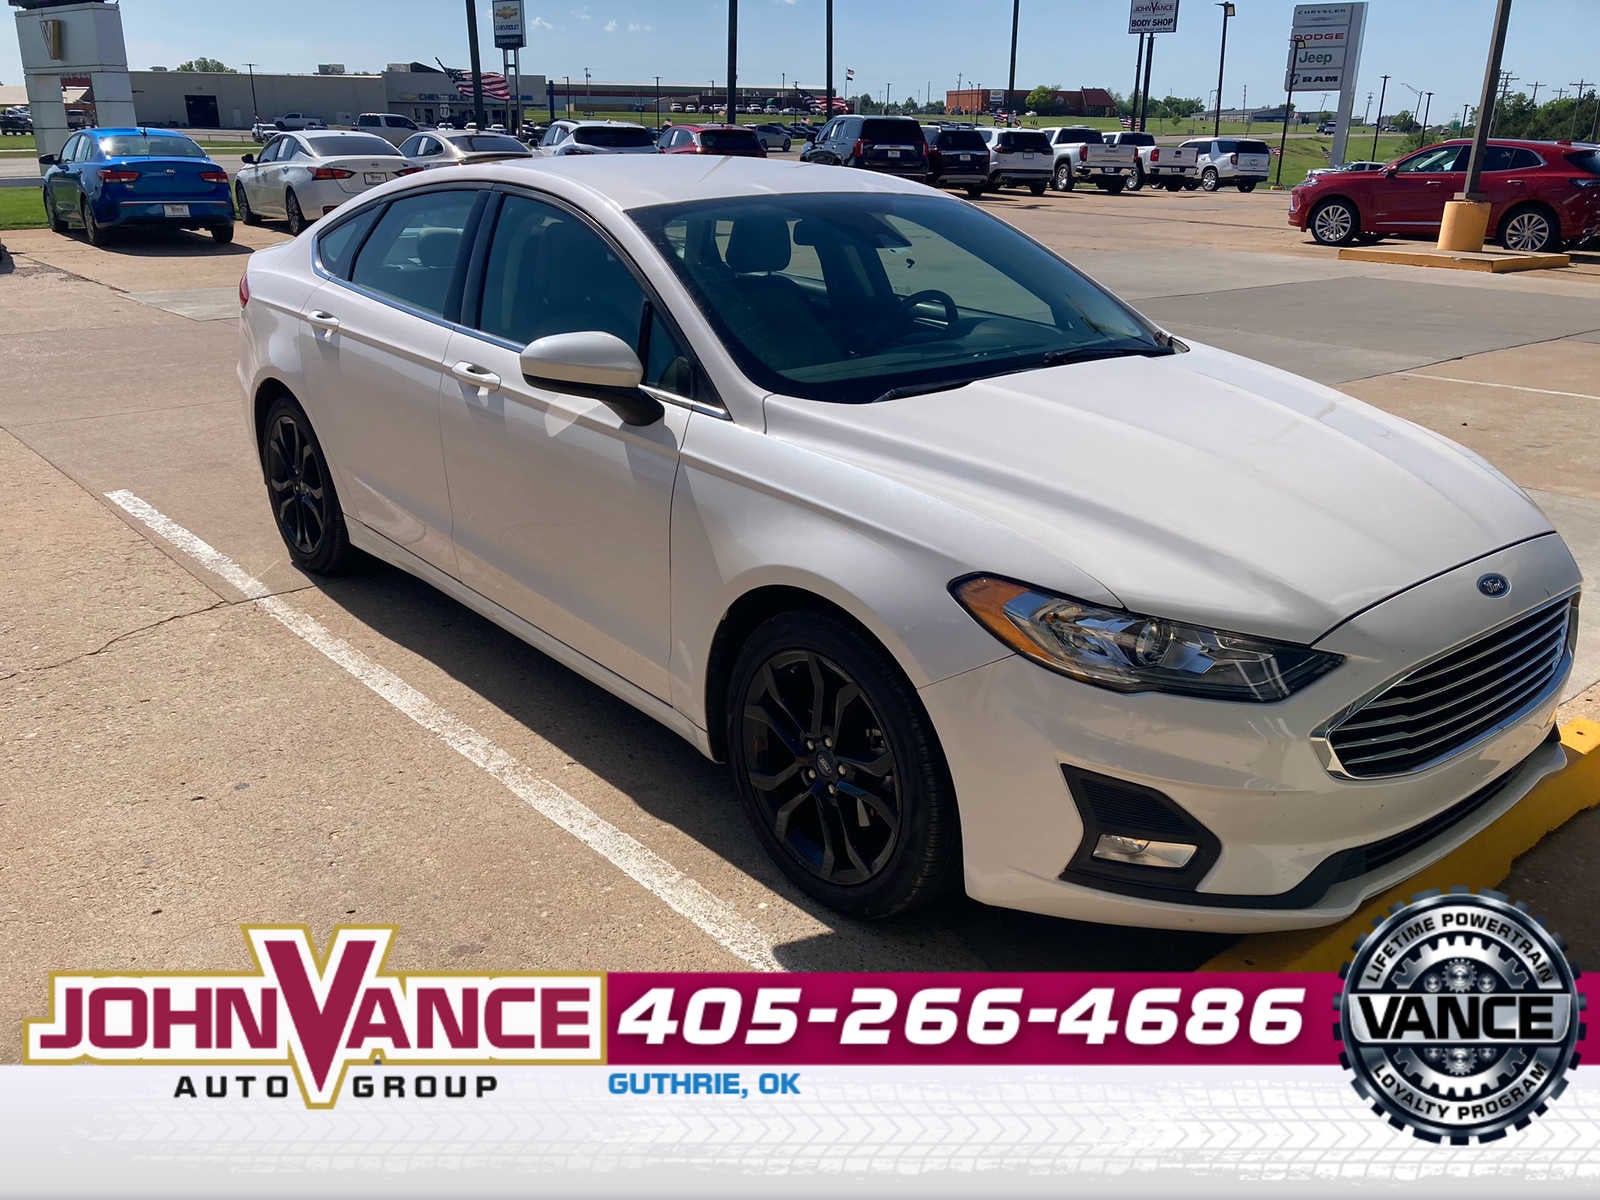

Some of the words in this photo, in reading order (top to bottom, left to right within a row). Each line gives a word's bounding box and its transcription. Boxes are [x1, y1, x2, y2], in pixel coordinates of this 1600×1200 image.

[1131, 19, 1151, 27] BODY
[1152, 18, 1173, 26] SHOP
[1294, 32, 1345, 41] DODGE
[1299, 51, 1332, 65] Jeep
[1302, 75, 1339, 83] RAM
